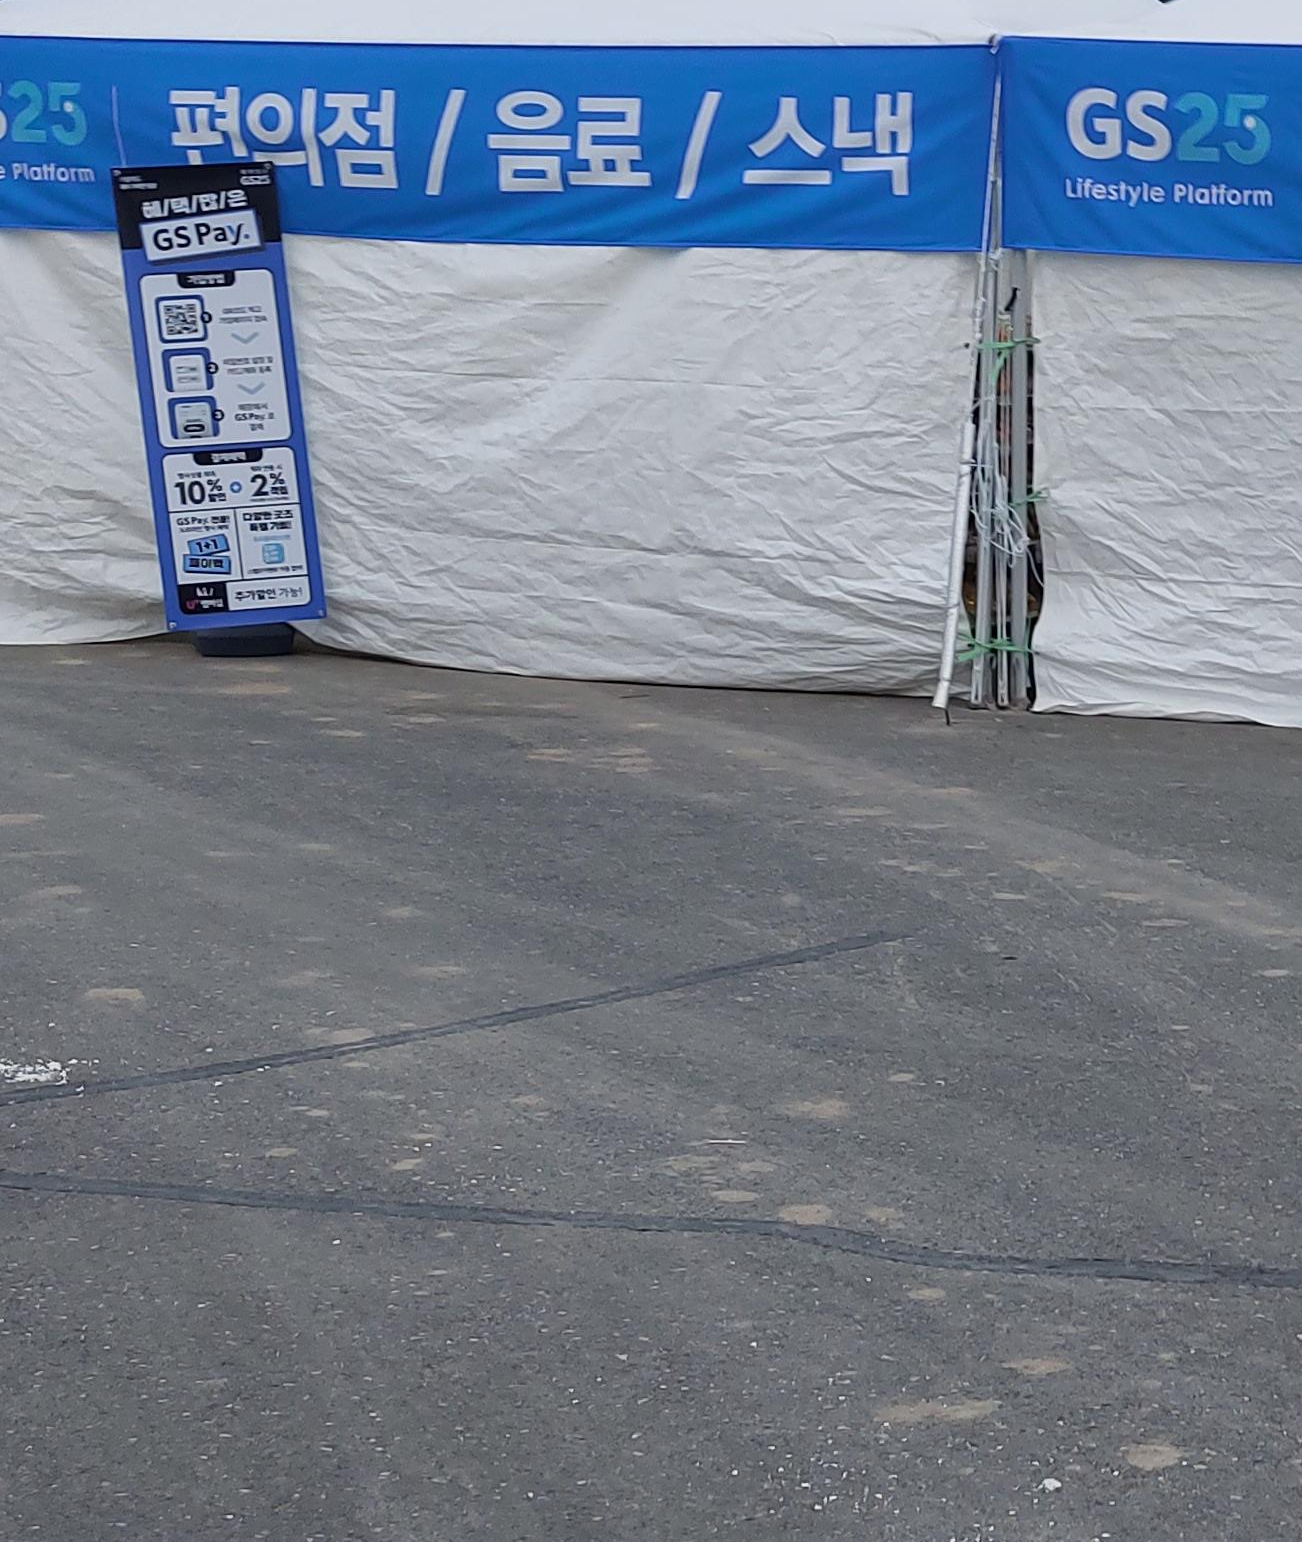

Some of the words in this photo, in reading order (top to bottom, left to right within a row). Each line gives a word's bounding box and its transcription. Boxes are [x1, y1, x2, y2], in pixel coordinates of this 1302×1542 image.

[0, 80, 87, 146] 25
[1066, 87, 1272, 165] GS25
[168, 87, 399, 190] 편의점
[427, 90, 466, 196] /
[487, 91, 651, 193] 음료
[677, 92, 721, 200] /
[743, 92, 913, 196] 스낵
[12, 162, 95, 182] Platform
[1065, 177, 1165, 207] Lifestyle
[1173, 183, 1273, 207] Platform
[153, 225, 192, 251] GS
[195, 222, 251, 246] Pay.
[174, 478, 223, 506] 10%
[250, 472, 285, 497] 2%
